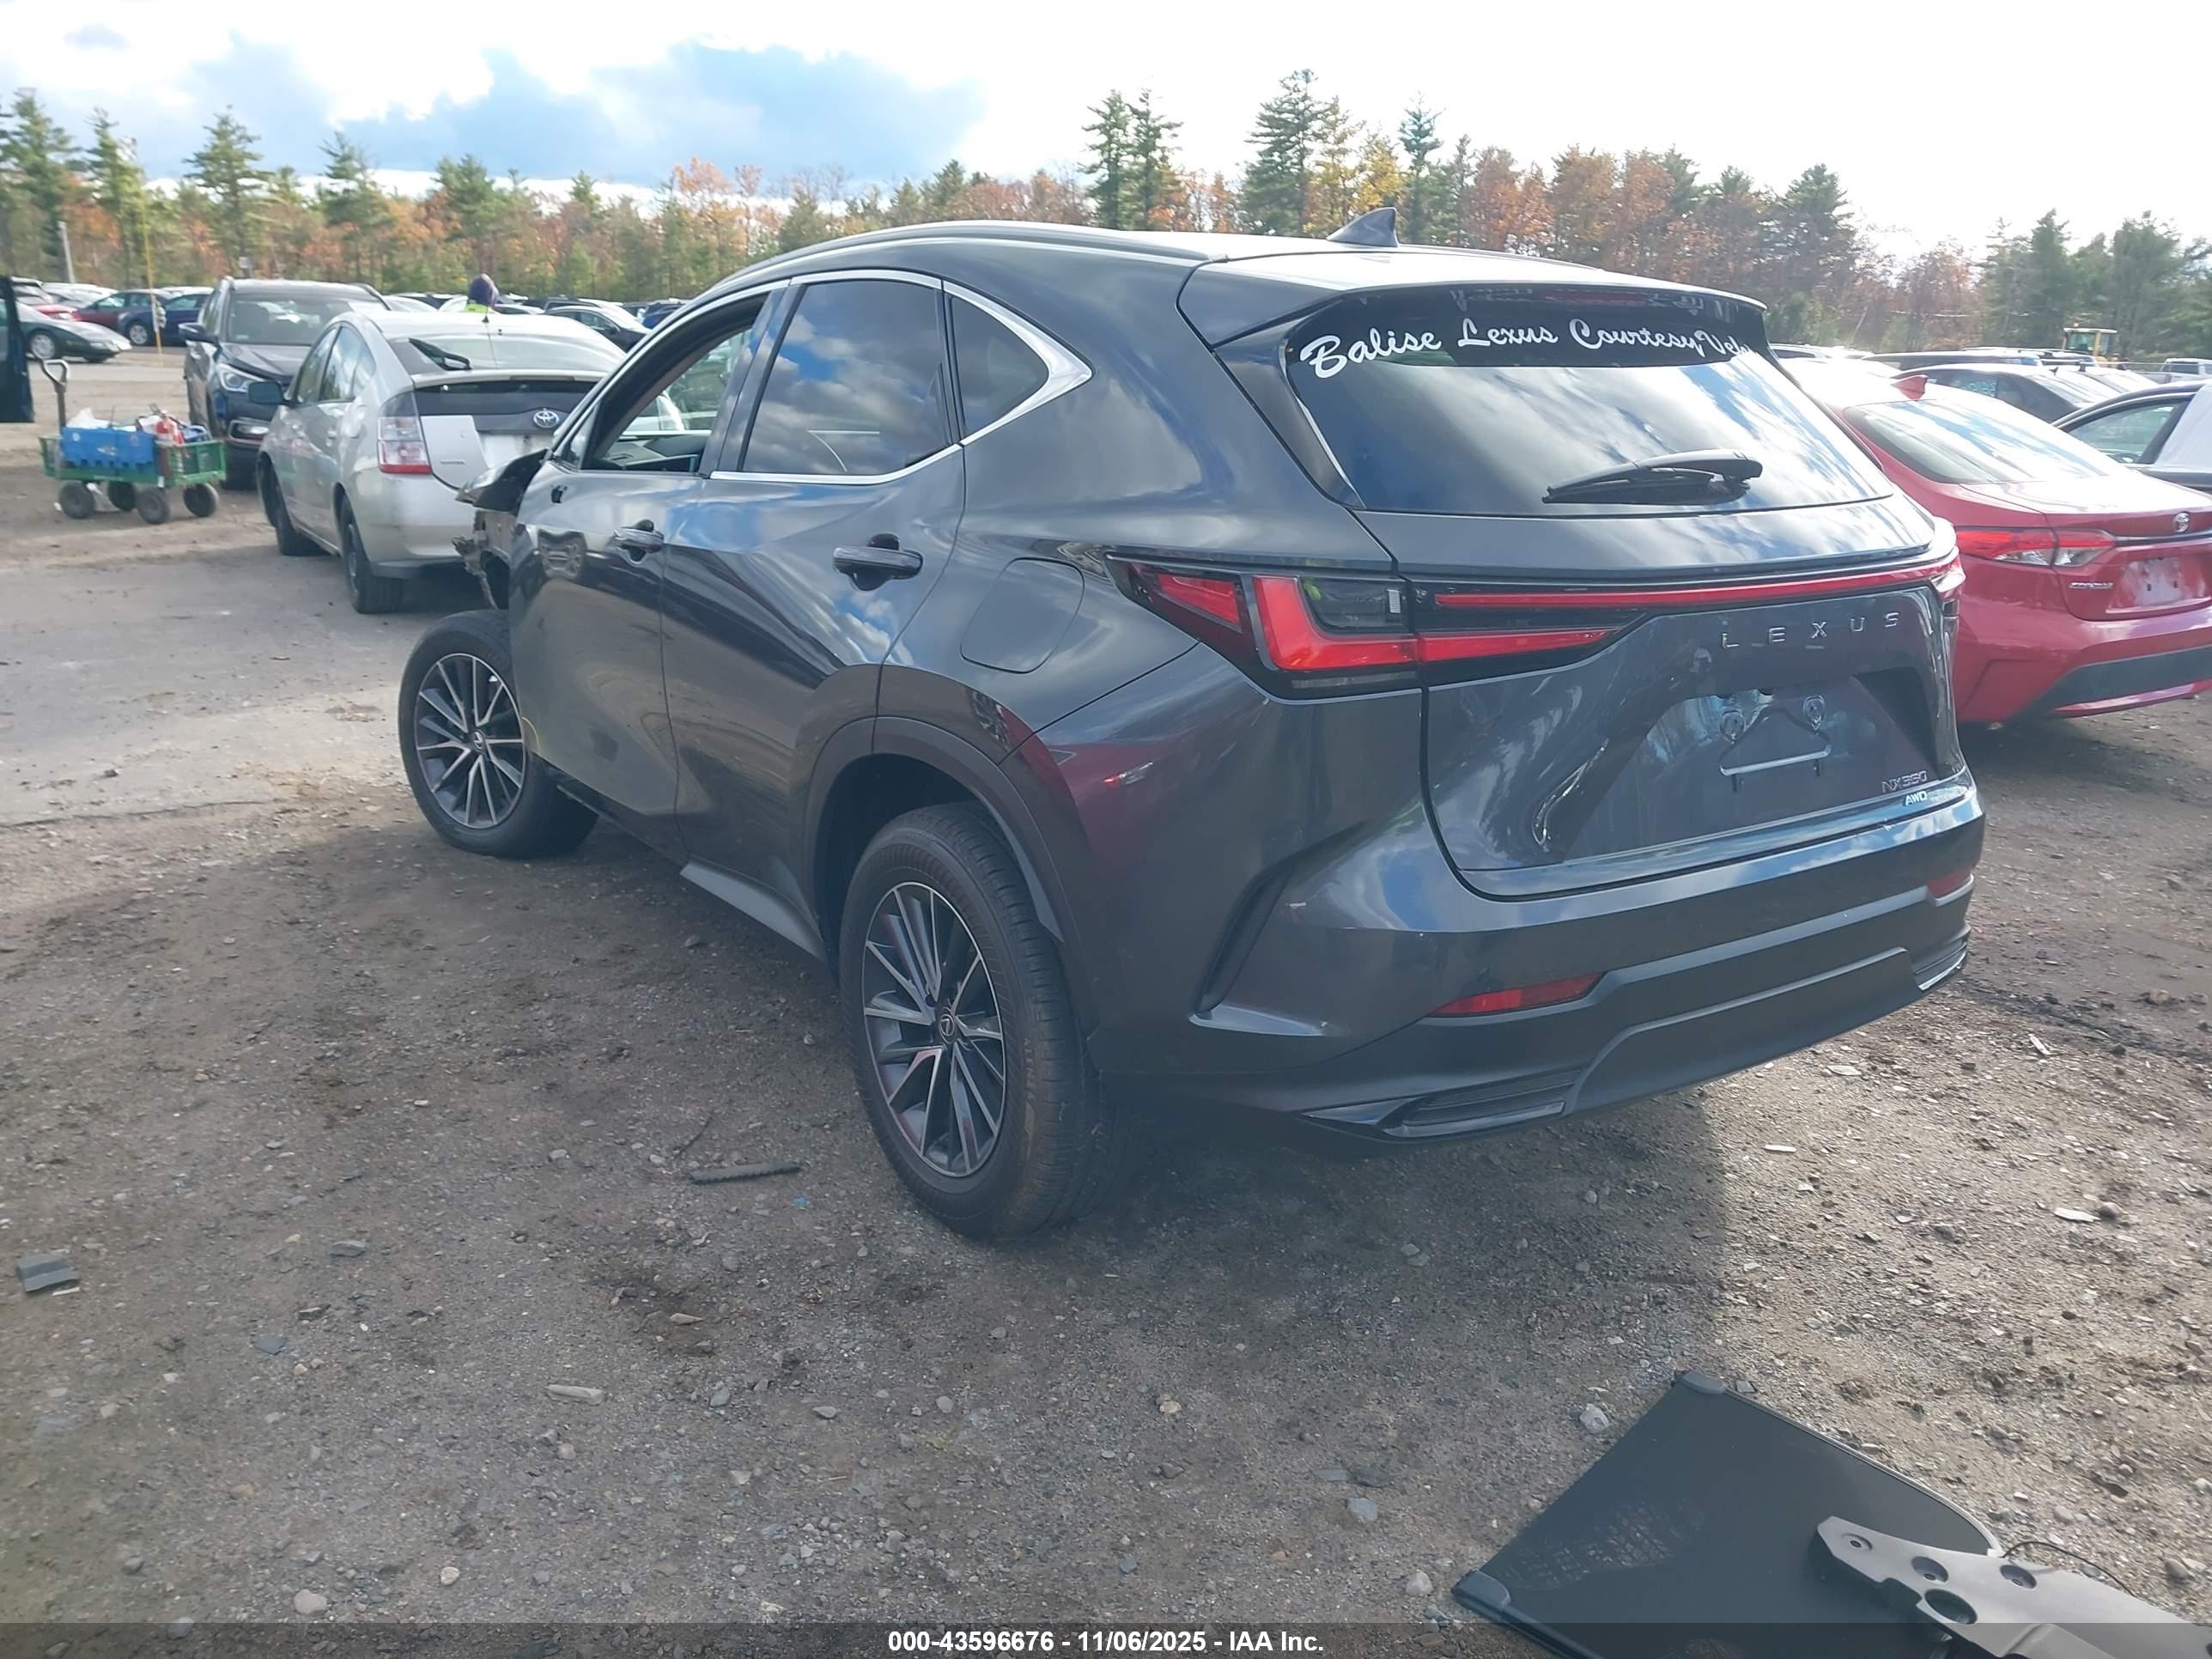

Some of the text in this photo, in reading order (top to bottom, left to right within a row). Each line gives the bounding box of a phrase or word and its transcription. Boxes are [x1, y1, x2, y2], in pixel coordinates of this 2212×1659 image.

[1299, 327, 1443, 379] Balise
[1457, 317, 1559, 348] Lexus
[1568, 318, 1705, 358] Courtesy
[1722, 611, 1900, 649] LEXUS
[1905, 790, 1929, 806] AWD
